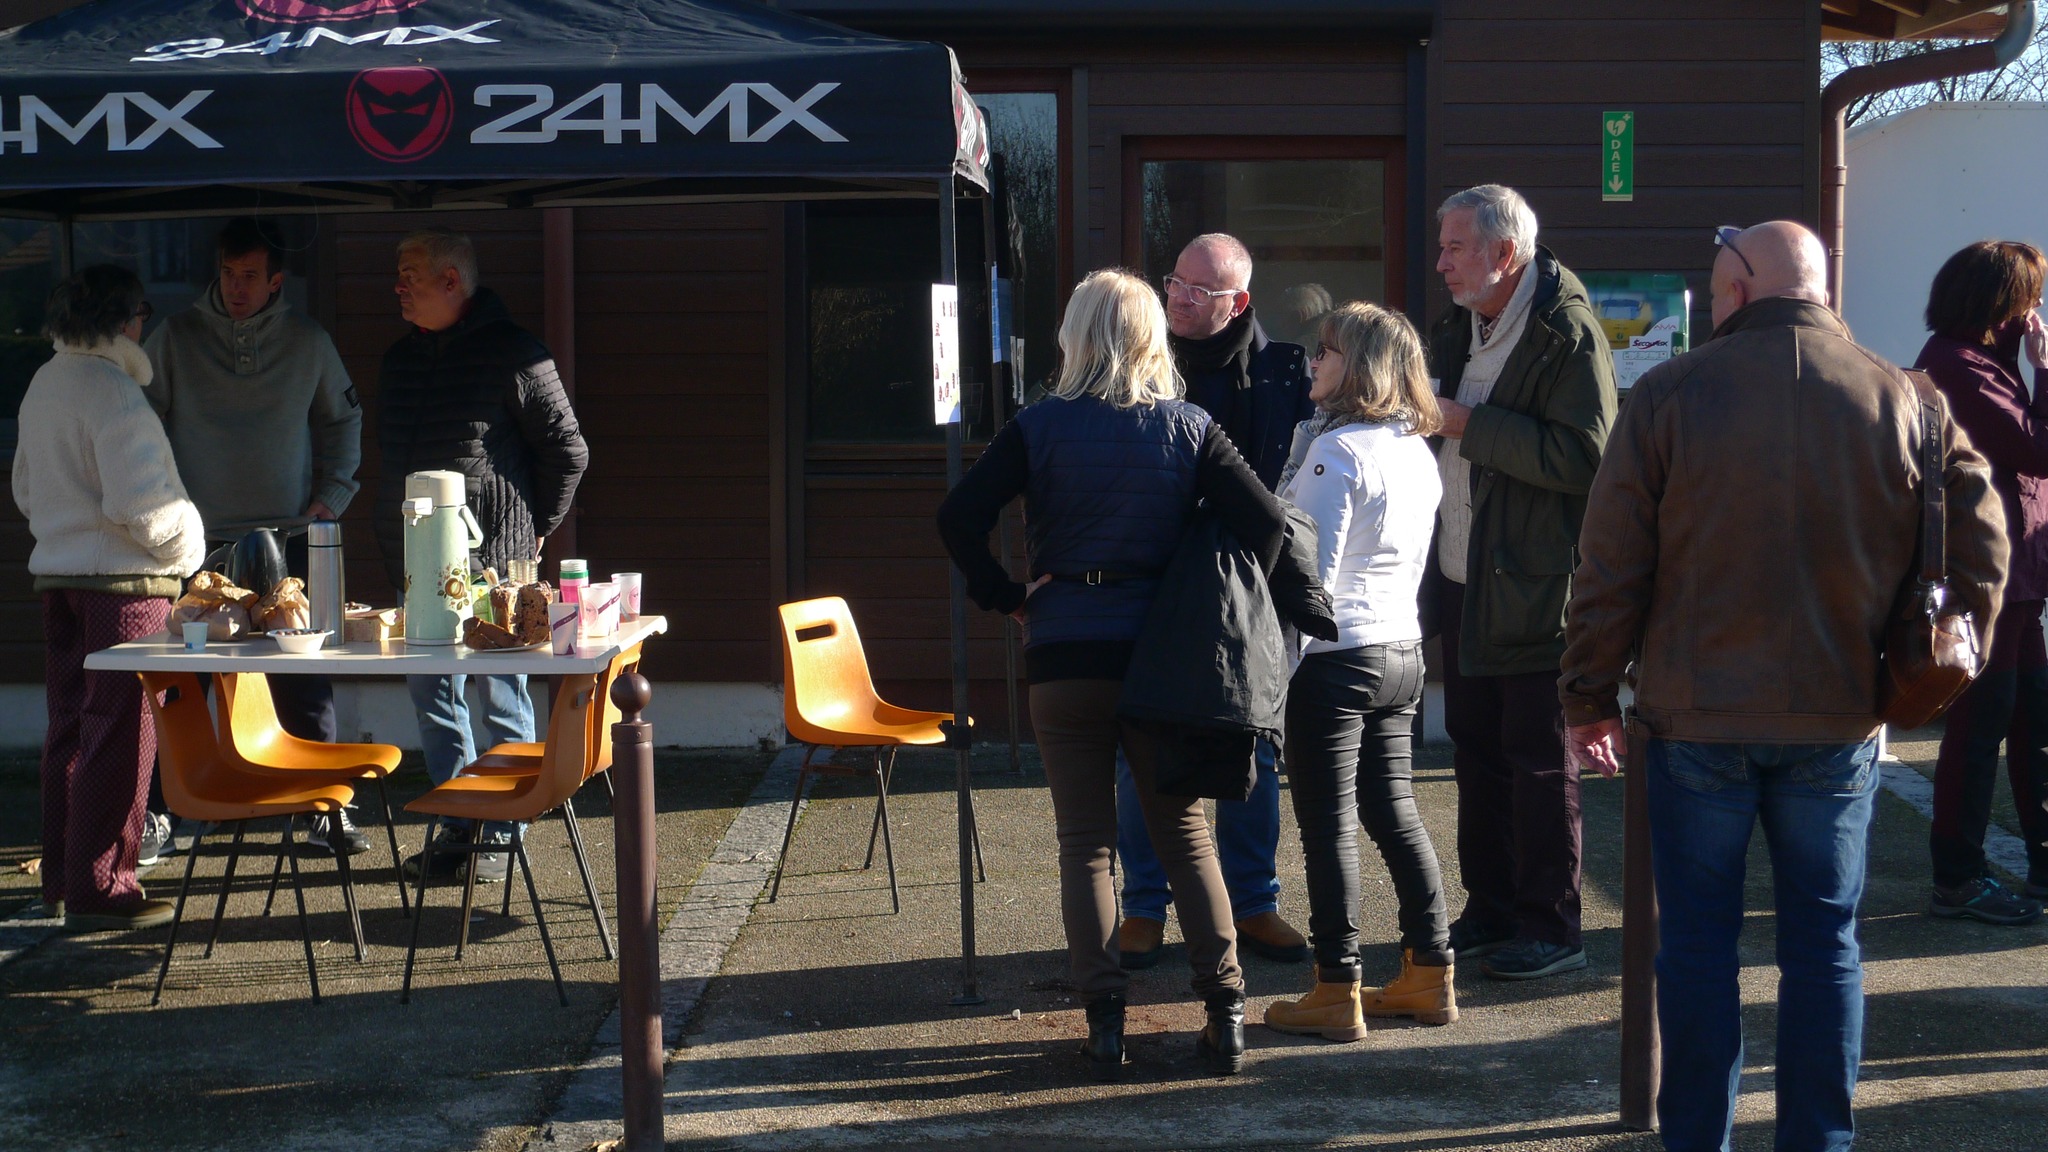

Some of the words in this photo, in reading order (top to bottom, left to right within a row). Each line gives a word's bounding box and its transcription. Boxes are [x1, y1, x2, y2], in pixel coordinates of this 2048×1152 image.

[130, 19, 501, 62] 24MX
[0, 90, 224, 155] MX
[470, 82, 850, 144] 24MX
[1611, 140, 1621, 172] DAE
